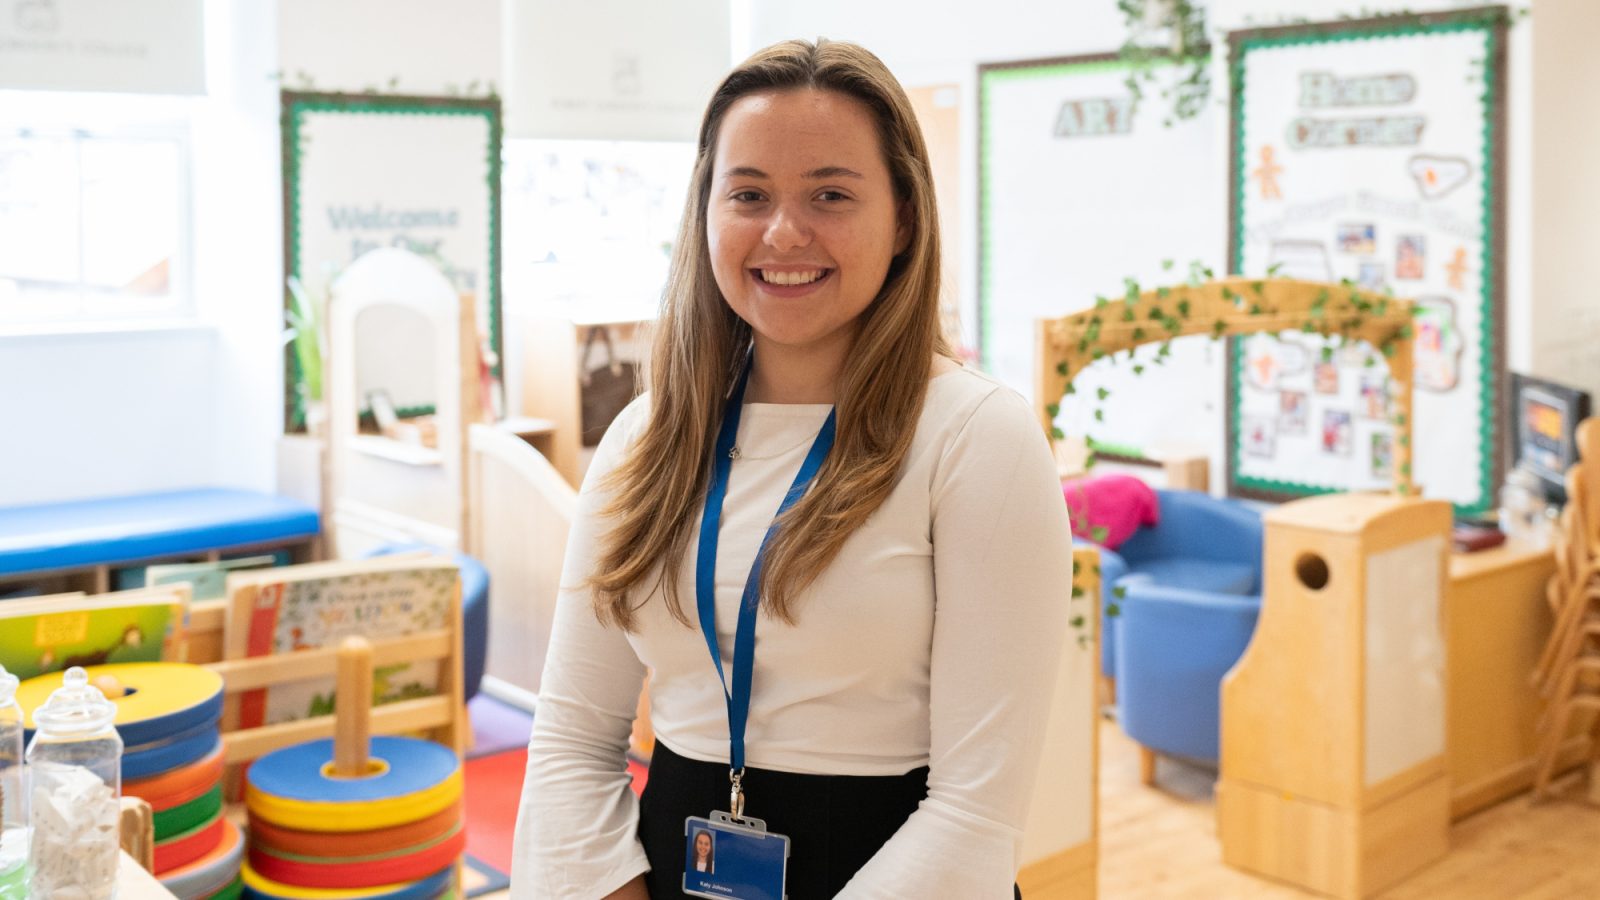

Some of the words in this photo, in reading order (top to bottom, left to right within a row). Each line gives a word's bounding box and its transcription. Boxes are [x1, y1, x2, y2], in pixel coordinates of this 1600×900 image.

[1299, 72, 1417, 106] Home
[1054, 99, 1133, 136] ART
[1286, 115, 1426, 149] Corner
[327, 204, 459, 231] Welcome
